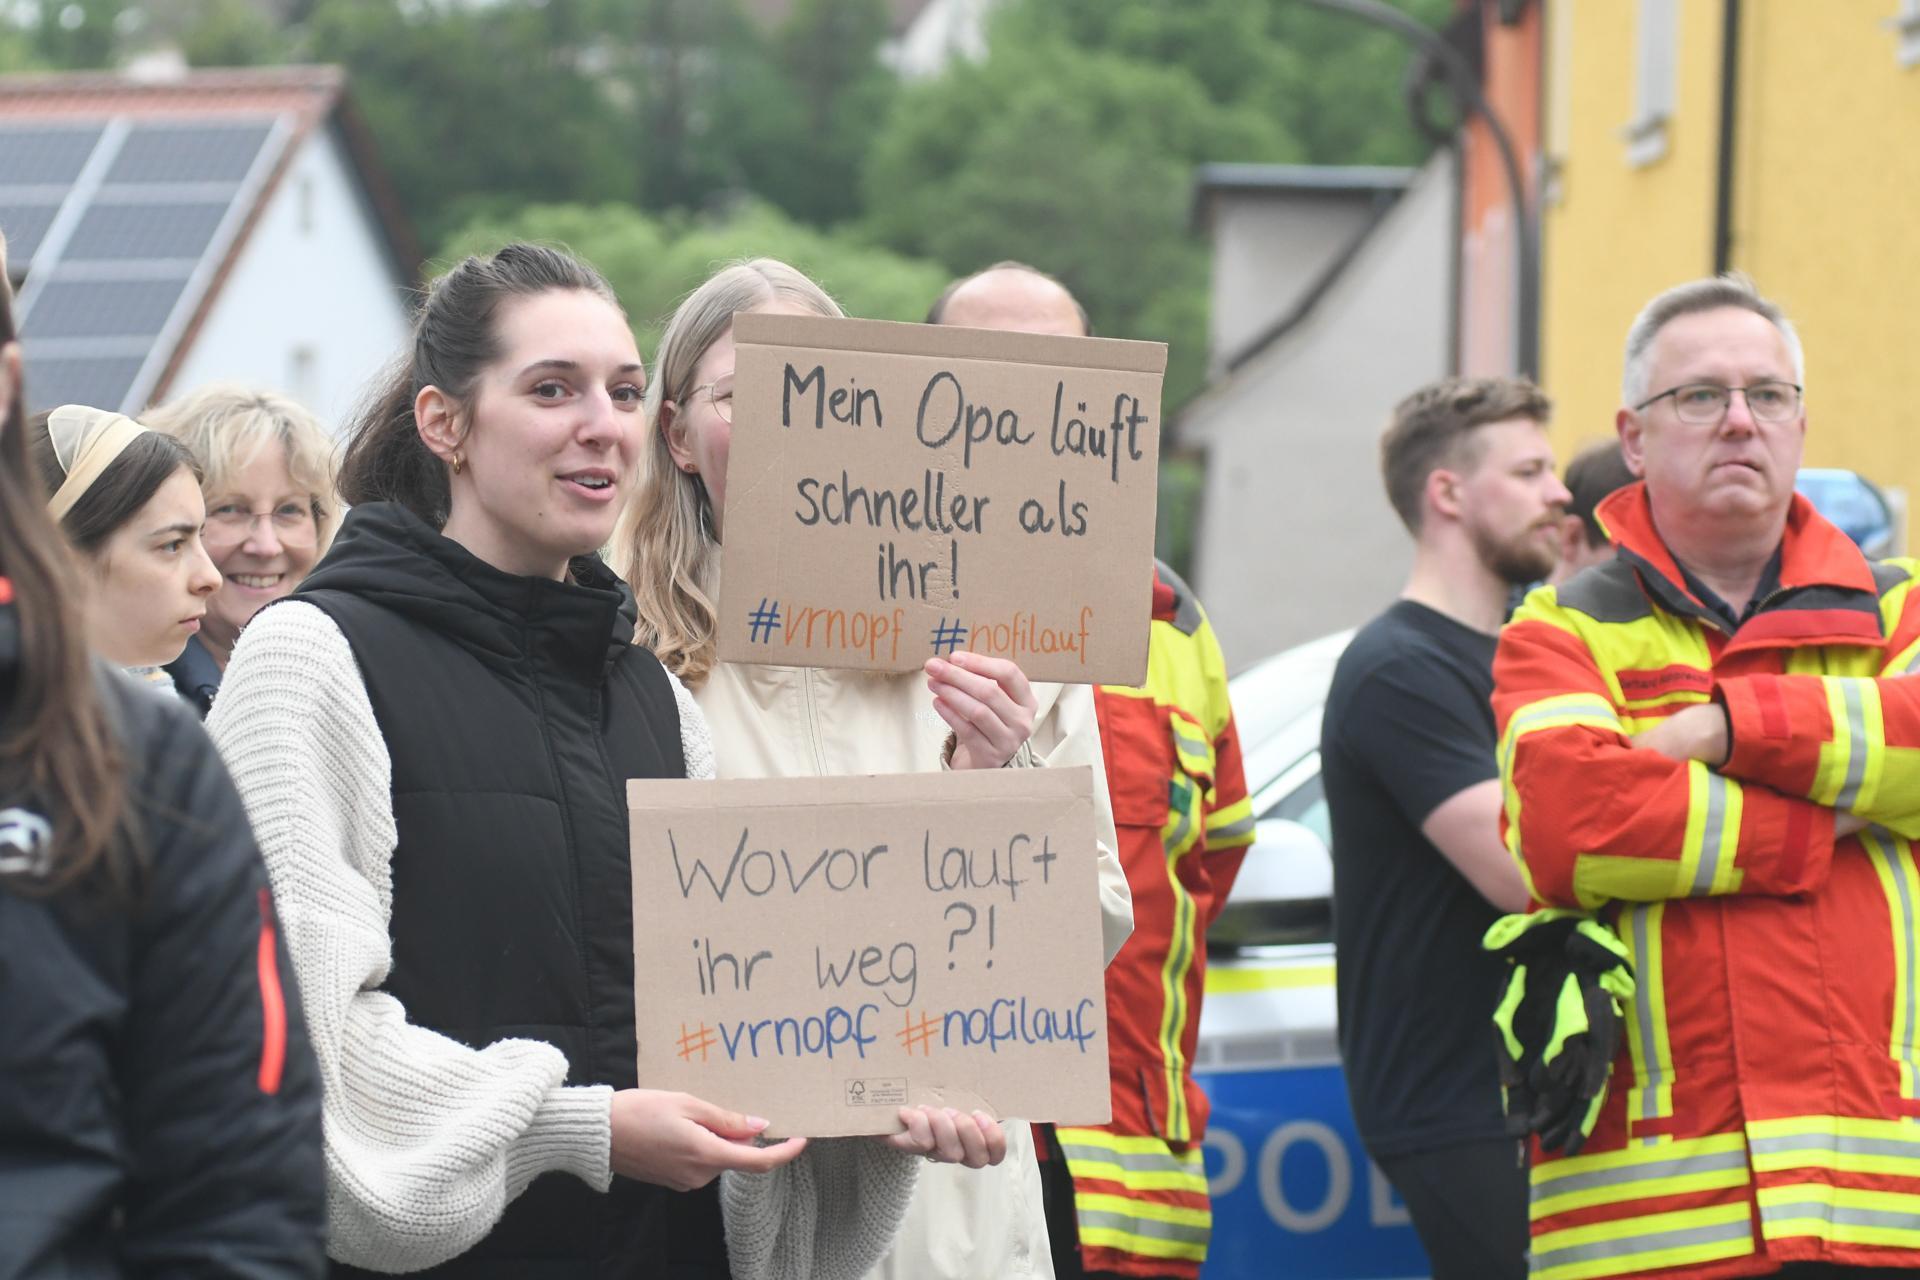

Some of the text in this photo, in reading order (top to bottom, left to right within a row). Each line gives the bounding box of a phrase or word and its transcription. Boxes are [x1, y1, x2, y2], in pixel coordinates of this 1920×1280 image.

[782, 362, 1149, 484] Mein Opa läuft
[795, 469, 1089, 536] schneller als
[877, 539, 960, 600] ihr!
[748, 598, 1093, 665] #vrnopf #nofilauf
[667, 827, 1057, 902] Wovor lauft
[693, 937, 773, 996] ihr
[815, 941, 918, 1008] weg
[676, 997, 1097, 1062] #vrnopf #nofilauf
